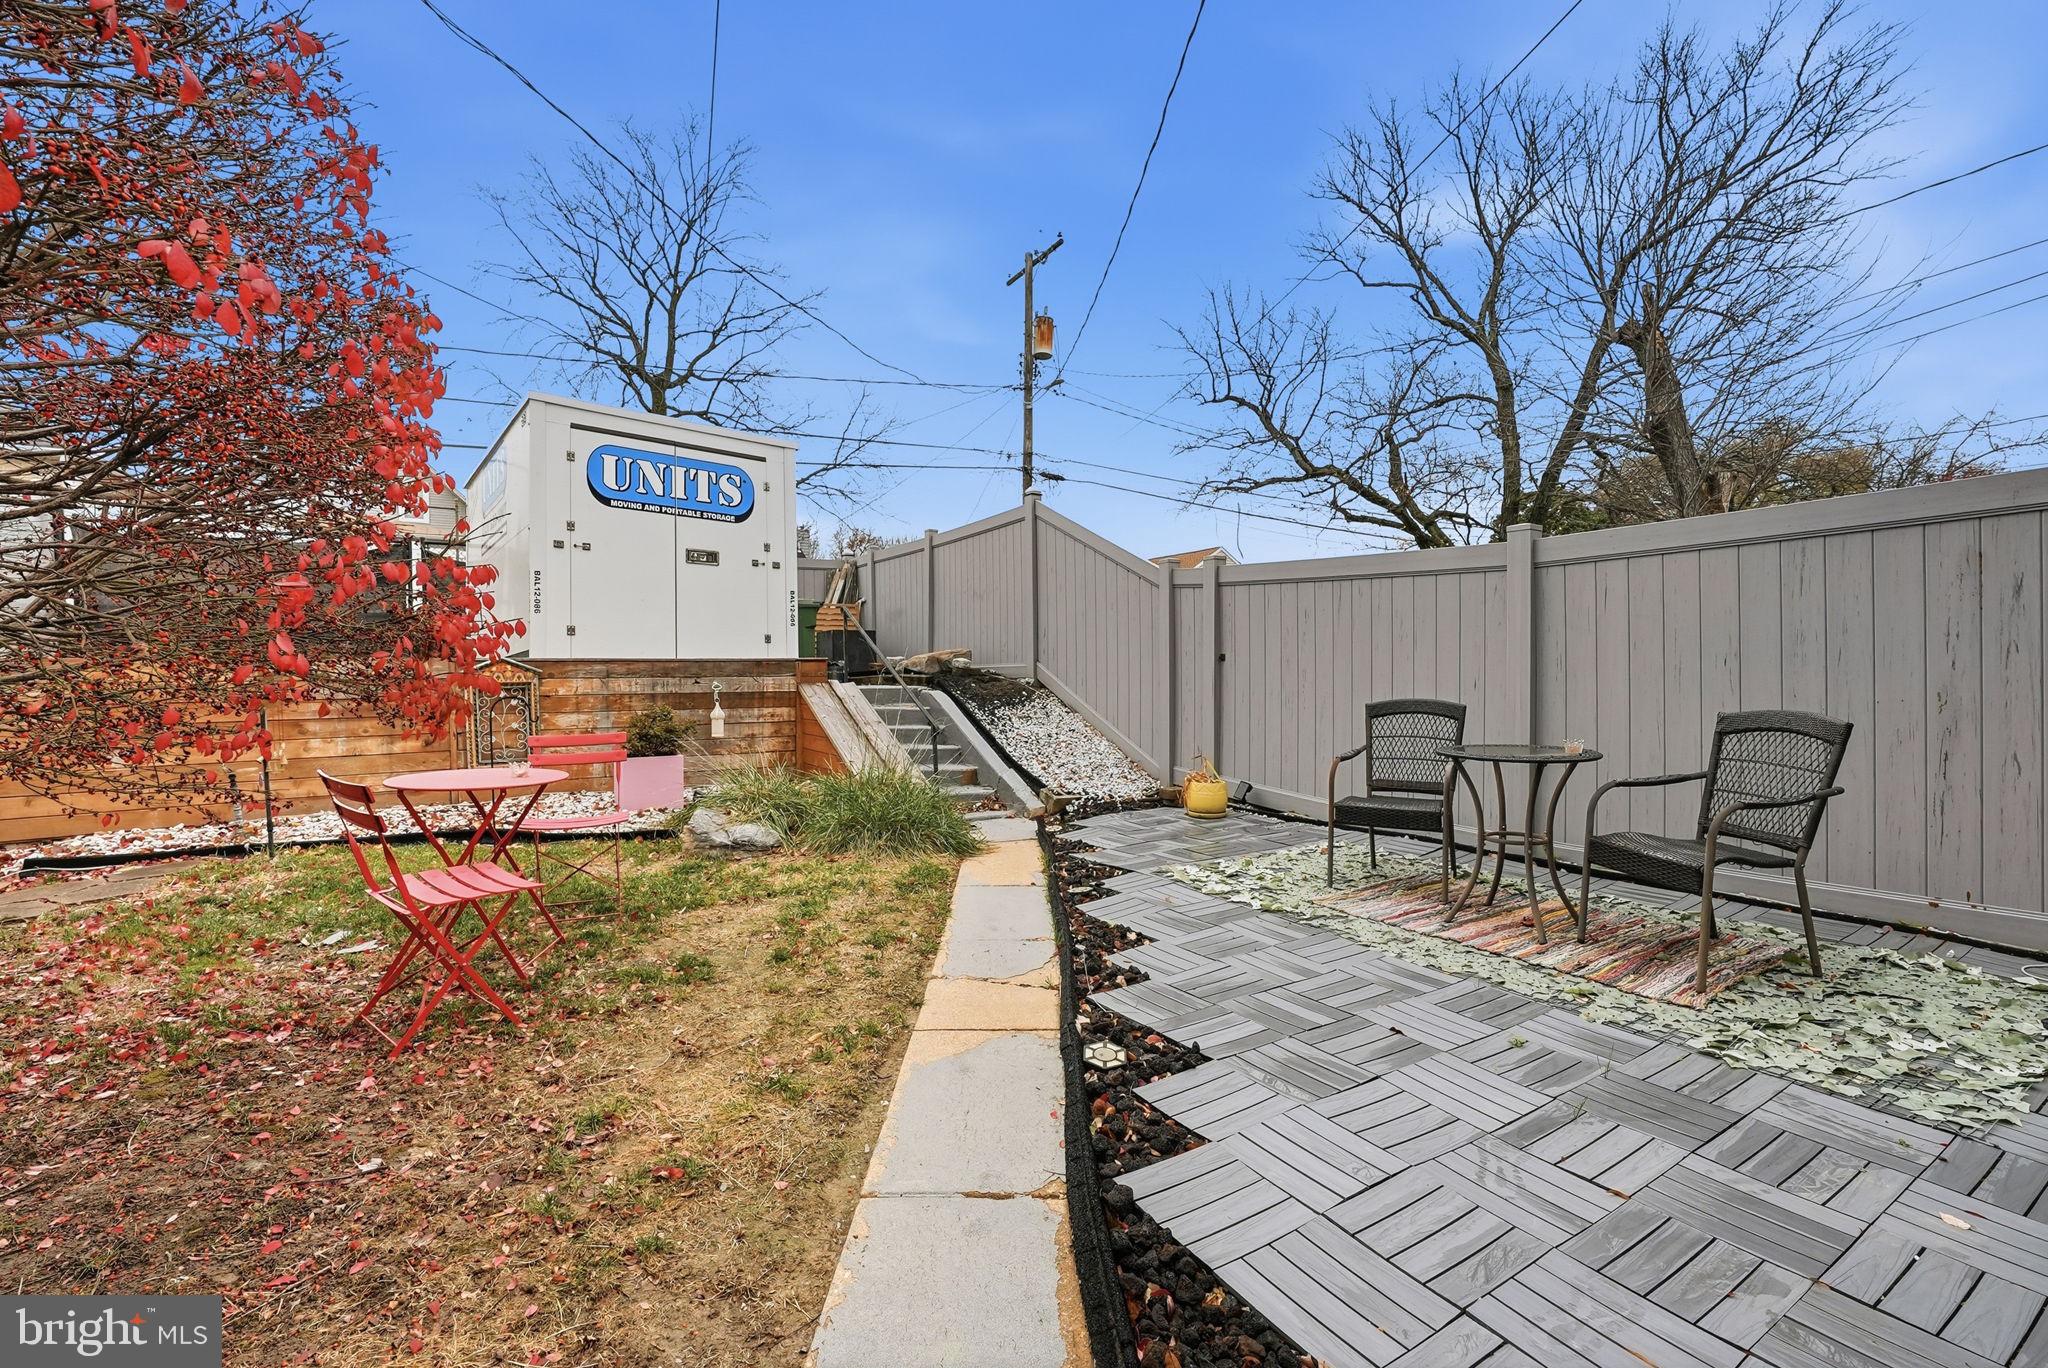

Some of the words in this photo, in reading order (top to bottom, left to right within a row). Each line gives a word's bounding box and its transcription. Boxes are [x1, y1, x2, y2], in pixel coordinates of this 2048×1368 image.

[600, 454, 743, 508] UNITS
[610, 499, 643, 510] MOVING
[643, 504, 661, 512] AND
[661, 507, 701, 518] PORTABLE
[702, 511, 736, 522] STORAGE
[533, 570, 541, 614] BAL12-086
